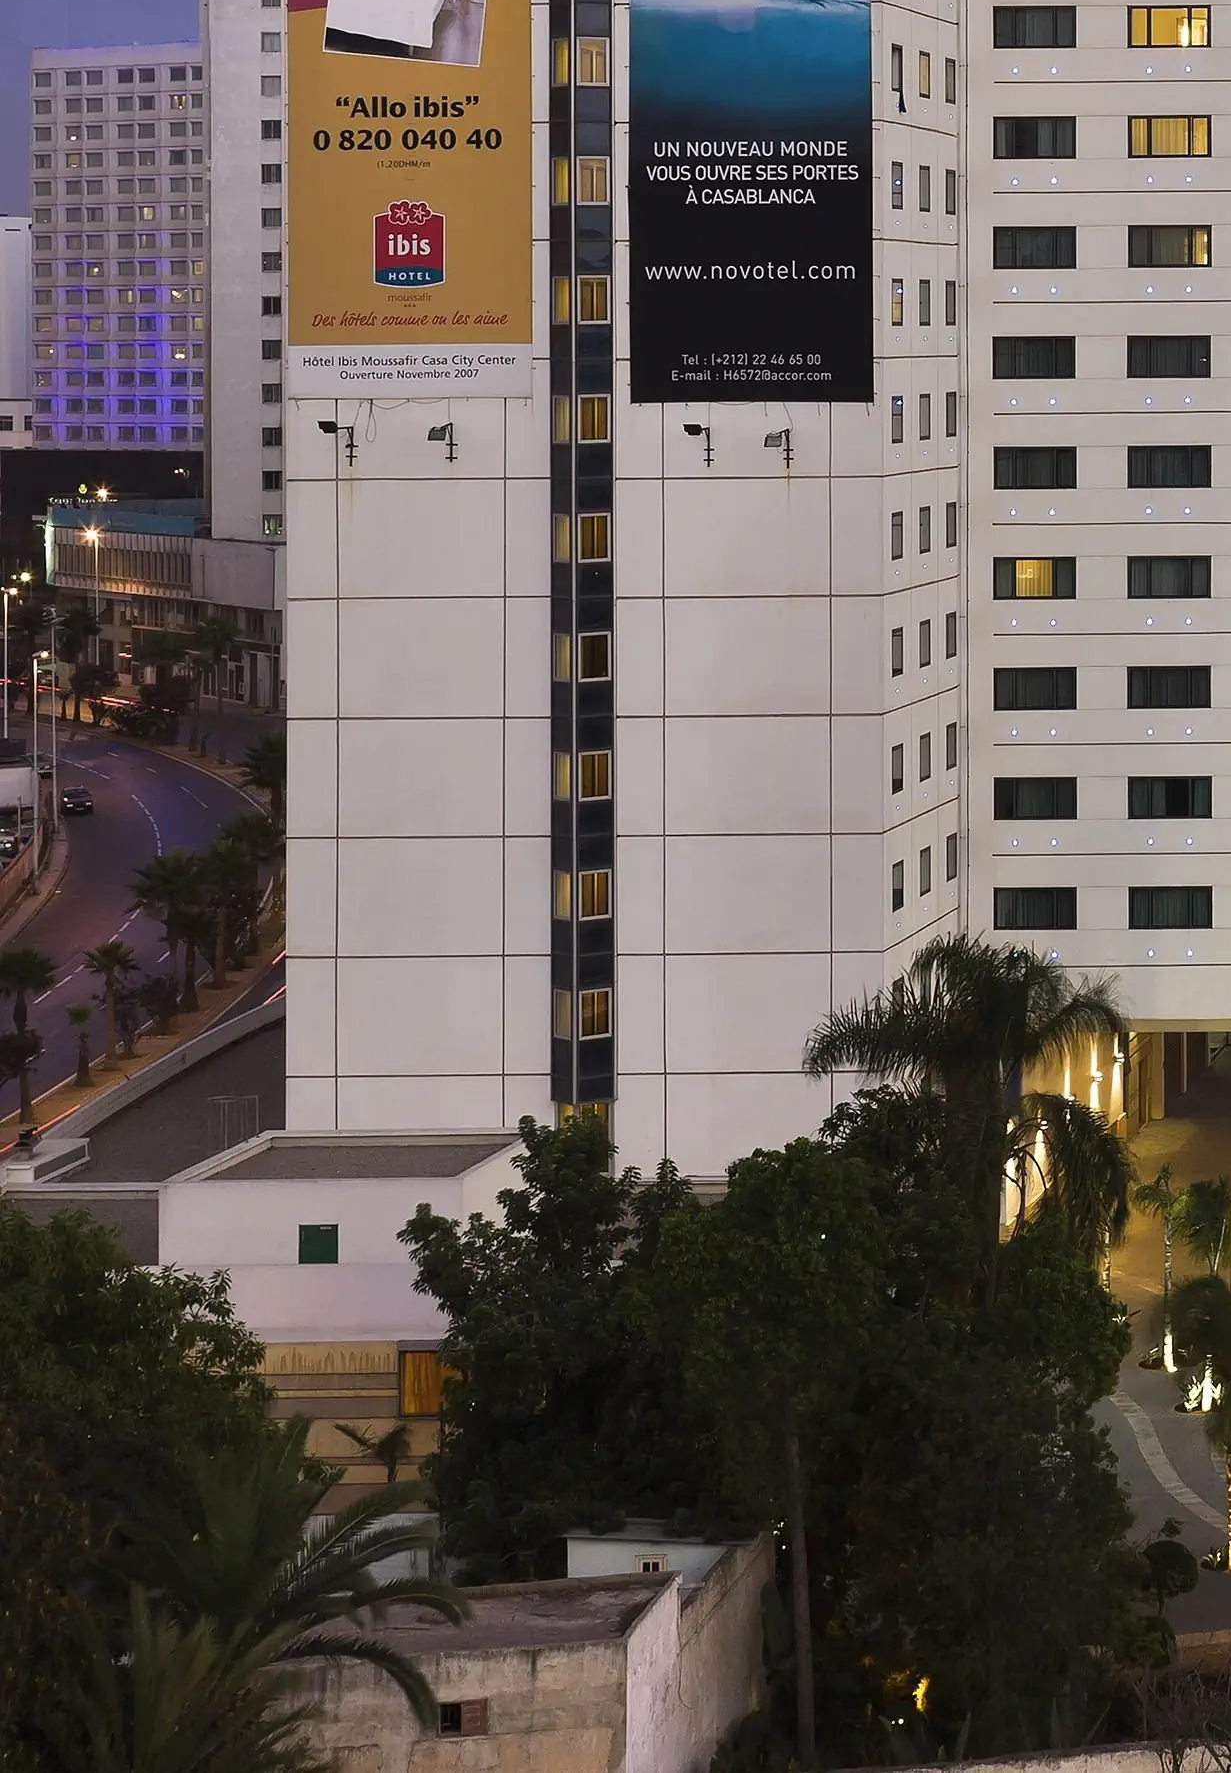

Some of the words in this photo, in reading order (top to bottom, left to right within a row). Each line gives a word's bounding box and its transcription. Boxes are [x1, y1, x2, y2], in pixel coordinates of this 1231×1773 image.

[313, 130, 331, 151] 0
[338, 130, 392, 151] 820
[401, 129, 457, 150] 040
[466, 128, 503, 150] 40
[653, 142, 680, 157] UN
[686, 141, 774, 157] NOUVEAU
[780, 141, 848, 157] MONDE
[646, 165, 691, 181] VOUS
[695, 165, 751, 180] OUVRE
[755, 165, 788, 180] SES
[793, 165, 859, 180] PORTES
[685, 185, 698, 204] À
[701, 189, 816, 204] CASABLANCA
[388, 234, 431, 256] ibis
[388, 272, 431, 281] HOTEL
[645, 260, 856, 280] www.novotel.com
[387, 293, 432, 303] moussafir
[311, 313, 336, 328] Des
[340, 310, 378, 327] hôtels
[451, 311, 469, 326] les
[303, 357, 335, 367] Hôtel
[338, 356, 358, 367] Ibis
[361, 356, 418, 367] Moussafir
[421, 356, 448, 366] Casa
[451, 355, 475, 369] City
[477, 354, 517, 366] Center
[681, 354, 700, 365] Tel
[711, 354, 748, 366] (+212)
[752, 354, 766, 365] 22
[770, 354, 785, 365] 46
[789, 354, 803, 365] 65
[806, 354, 822, 365] 00
[340, 370, 394, 380] Ouverture
[397, 369, 451, 379] Novembre
[454, 369, 479, 379] 2007
[671, 370, 712, 381] E-mail
[723, 370, 832, 381] H6572@accor.com
